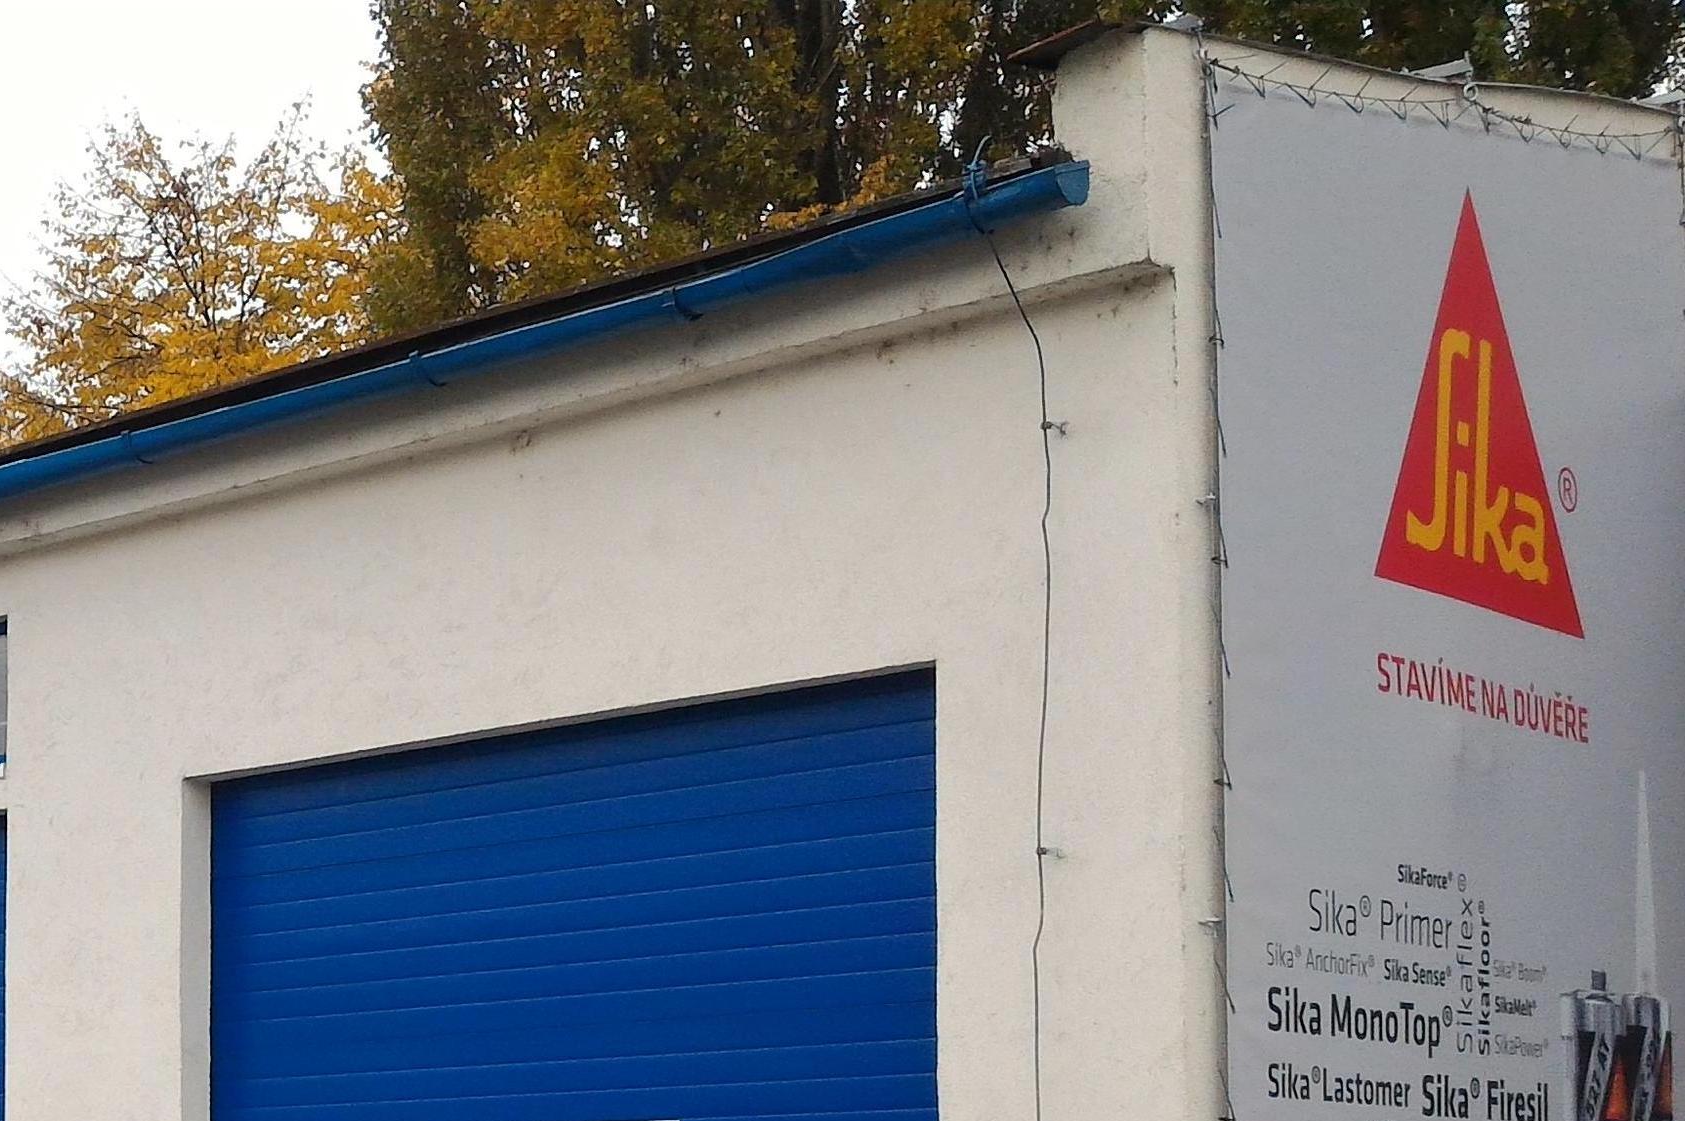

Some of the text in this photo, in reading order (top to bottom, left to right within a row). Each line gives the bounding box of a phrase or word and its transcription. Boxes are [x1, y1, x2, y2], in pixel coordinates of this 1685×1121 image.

[1406, 328, 1549, 585] Sika
[1377, 652, 1476, 713] STAVÍME
[1482, 679, 1509, 723] NA
[1380, 900, 1452, 949] Primer
[1384, 958, 1409, 982] Sika
[1268, 986, 1321, 1035] Sika
